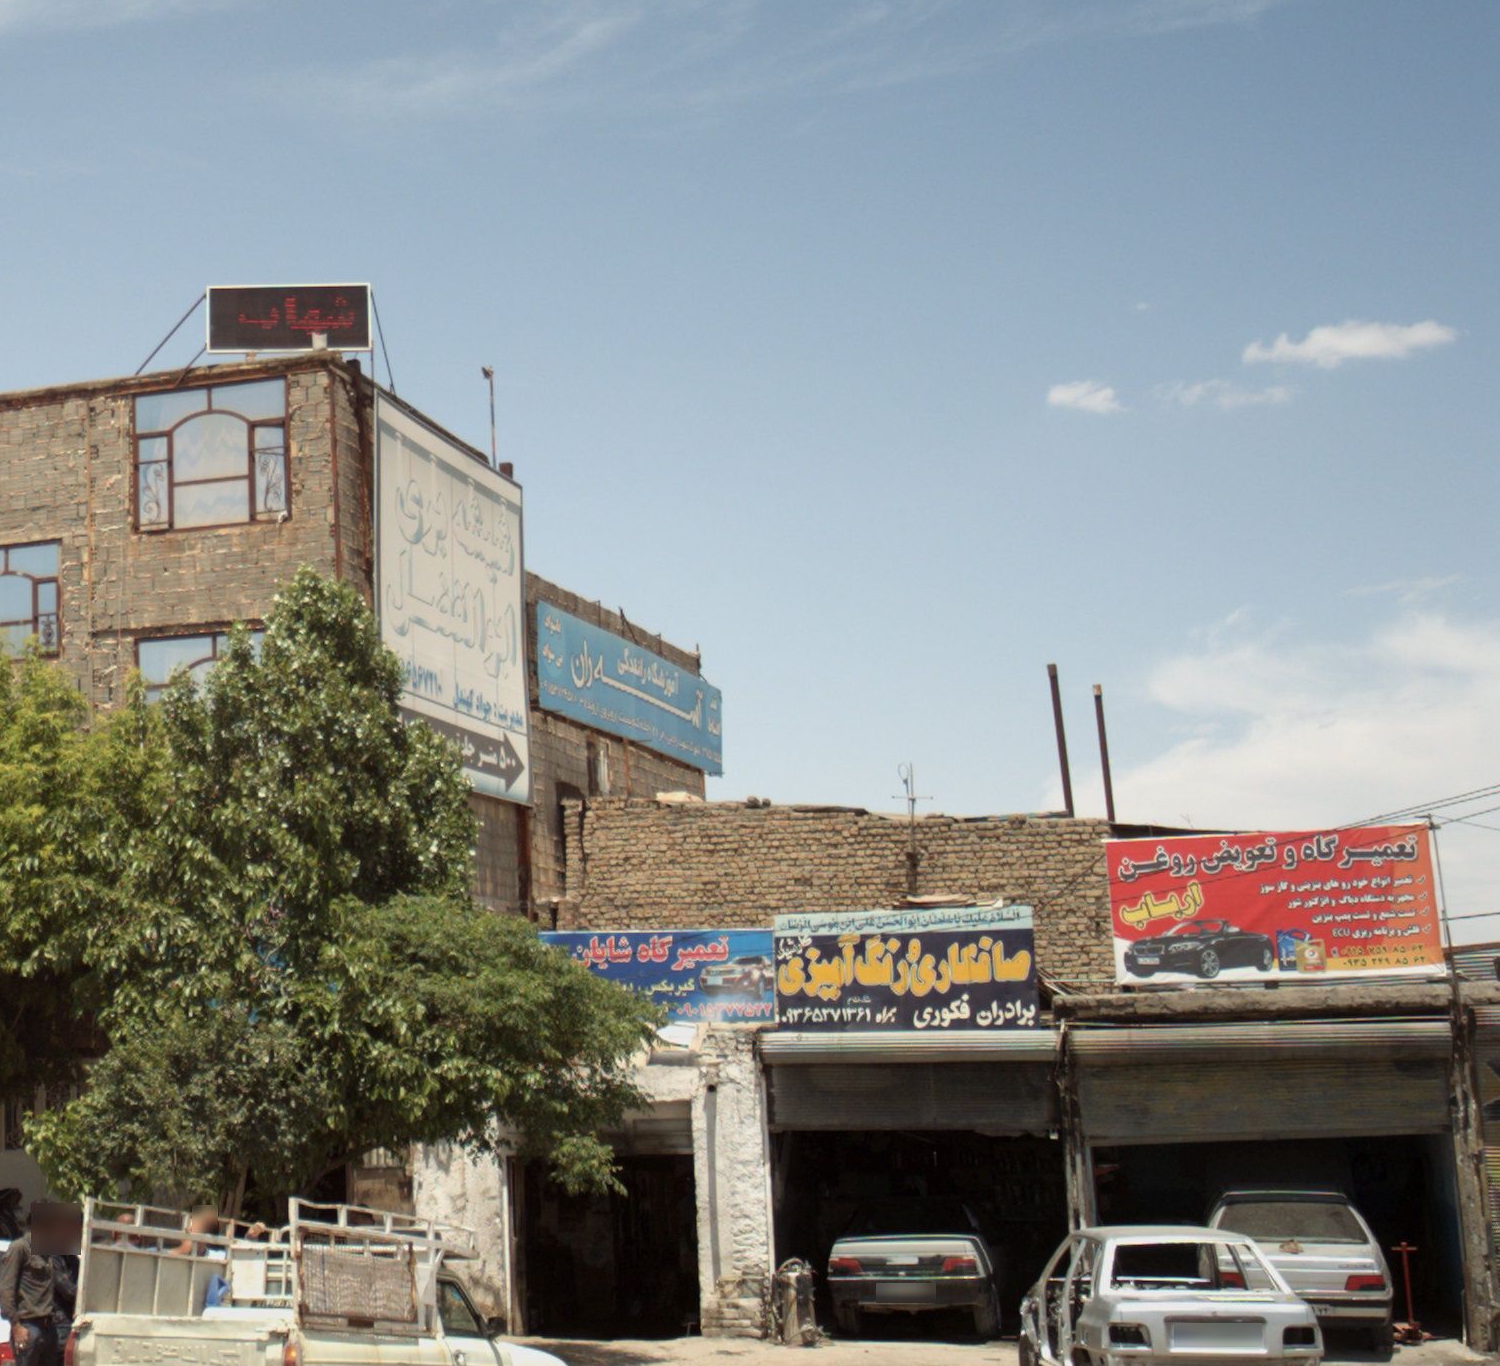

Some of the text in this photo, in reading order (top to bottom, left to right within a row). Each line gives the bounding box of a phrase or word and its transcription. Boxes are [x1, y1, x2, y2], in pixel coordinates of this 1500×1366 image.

[1118, 847, 1197, 882] روغن
[1201, 838, 1277, 872] تعویض
[1283, 846, 1297, 869] و
[1120, 881, 1203, 930] ارباب
[671, 935, 729, 971] تعمیر
[913, 994, 1036, 1028] برادران فکوری
